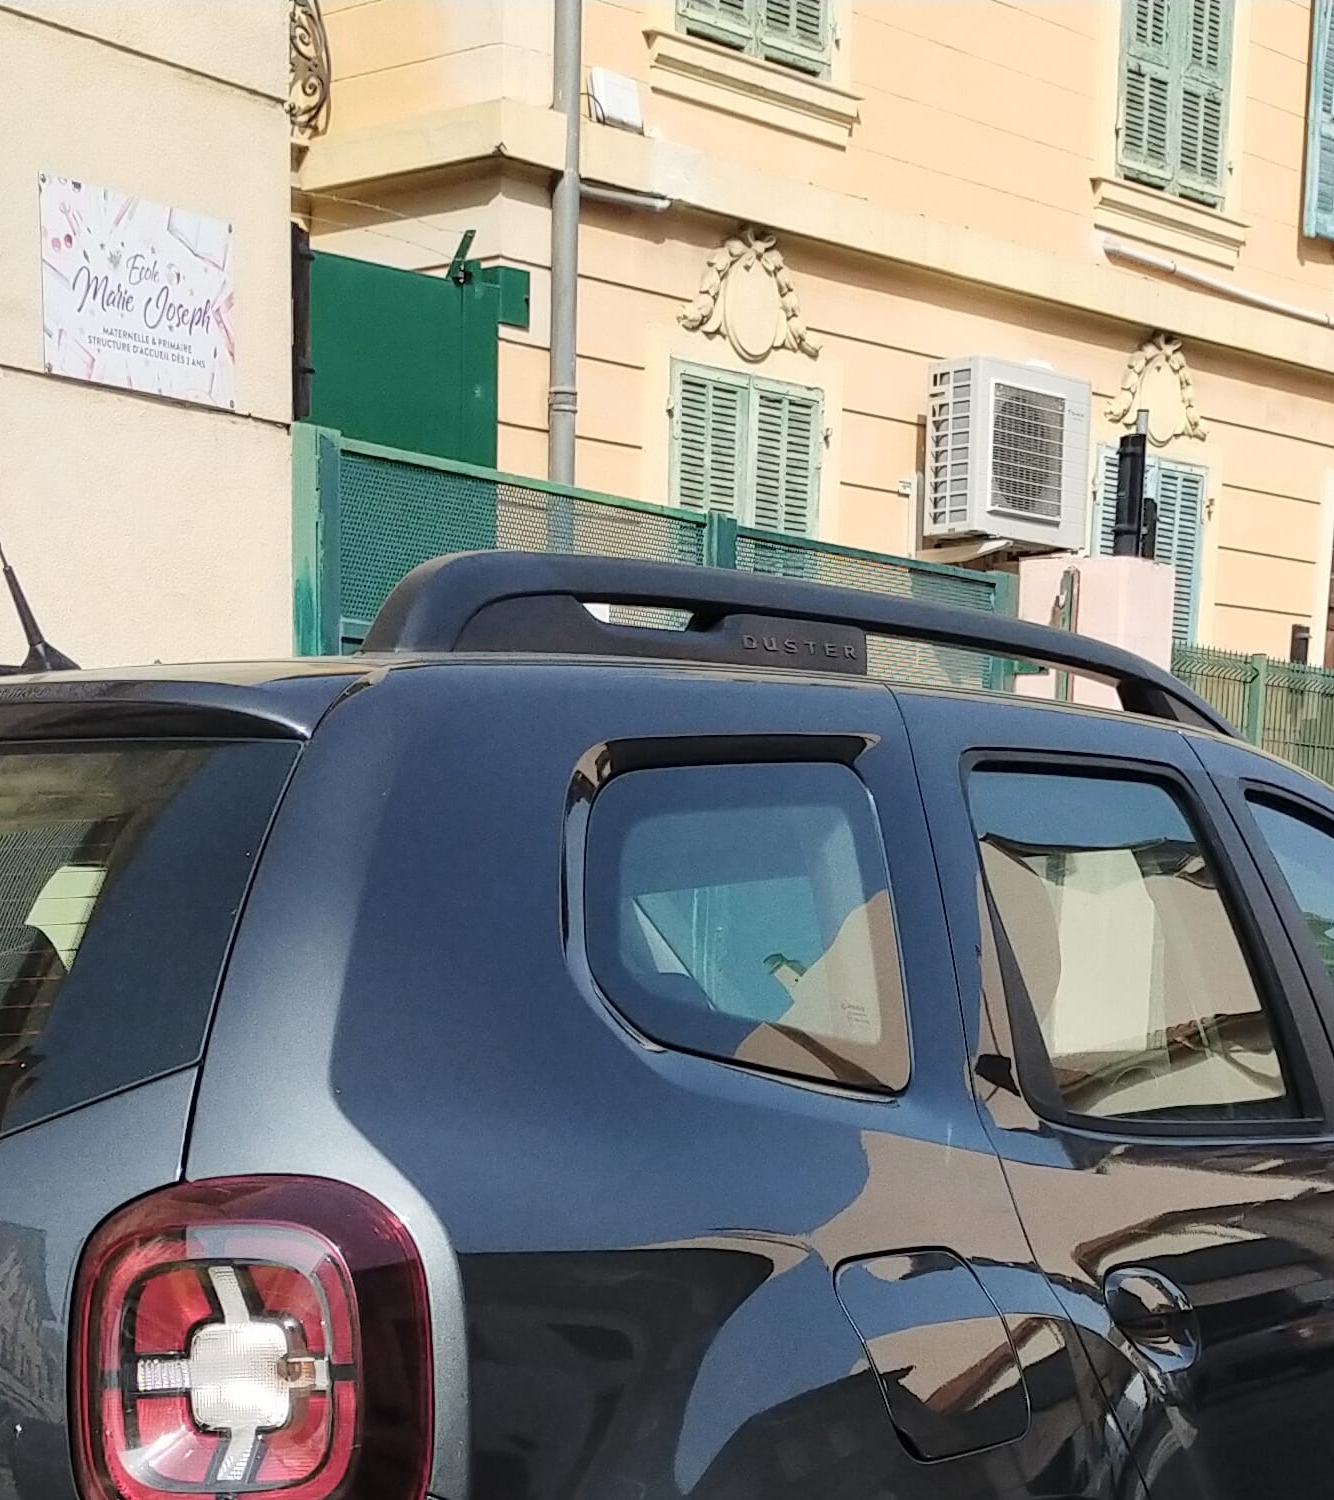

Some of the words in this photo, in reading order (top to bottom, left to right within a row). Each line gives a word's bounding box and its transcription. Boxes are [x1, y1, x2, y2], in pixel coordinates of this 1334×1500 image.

[126, 254, 159, 285] Ecole
[72, 266, 134, 312] Marie
[144, 285, 211, 336] Joseph
[88, 335, 131, 353] STRUCTURE
[133, 345, 169, 361] D'ACCUEIL
[103, 327, 149, 344] MATERNELLE
[158, 338, 192, 354] PRIMAIRE
[742, 634, 857, 660] DUSTER
